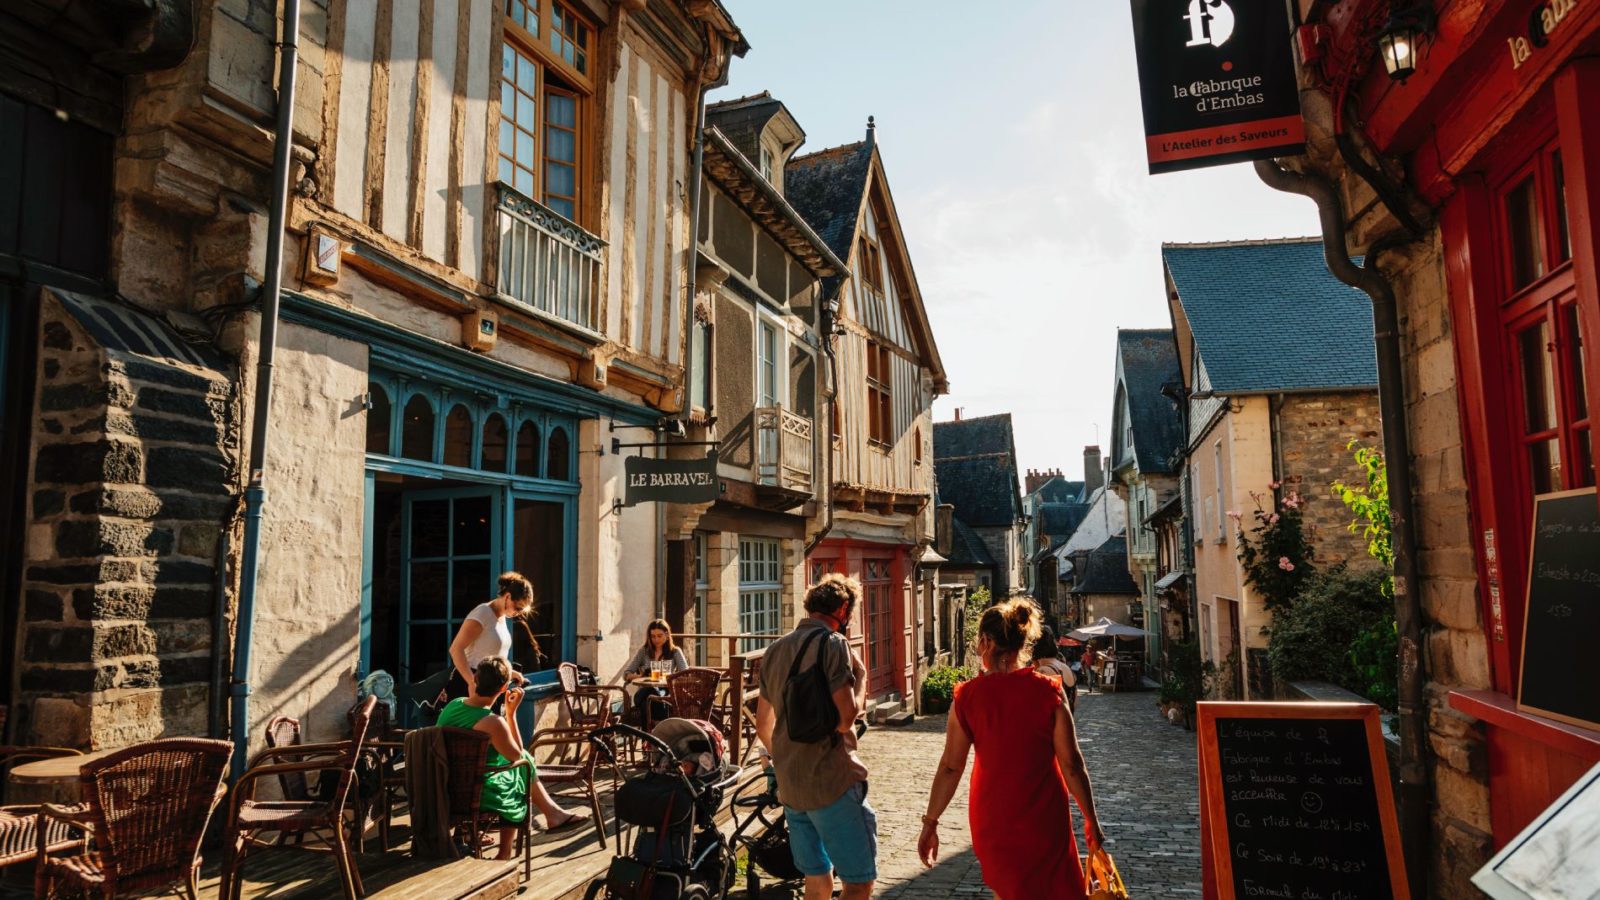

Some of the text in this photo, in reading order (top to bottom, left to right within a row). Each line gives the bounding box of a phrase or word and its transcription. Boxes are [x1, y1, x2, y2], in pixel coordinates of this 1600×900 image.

[1507, 36, 1532, 70] la
[1172, 84, 1189, 98] la
[1196, 92, 1264, 112] d'Embas
[1162, 126, 1289, 153] L'Atelier des Saveurs
[630, 473, 647, 487] LE
[649, 472, 713, 487] BARRAVEL
[1286, 728, 1304, 741] de
[1308, 773, 1325, 785] de
[1334, 775, 1363, 785] vous
